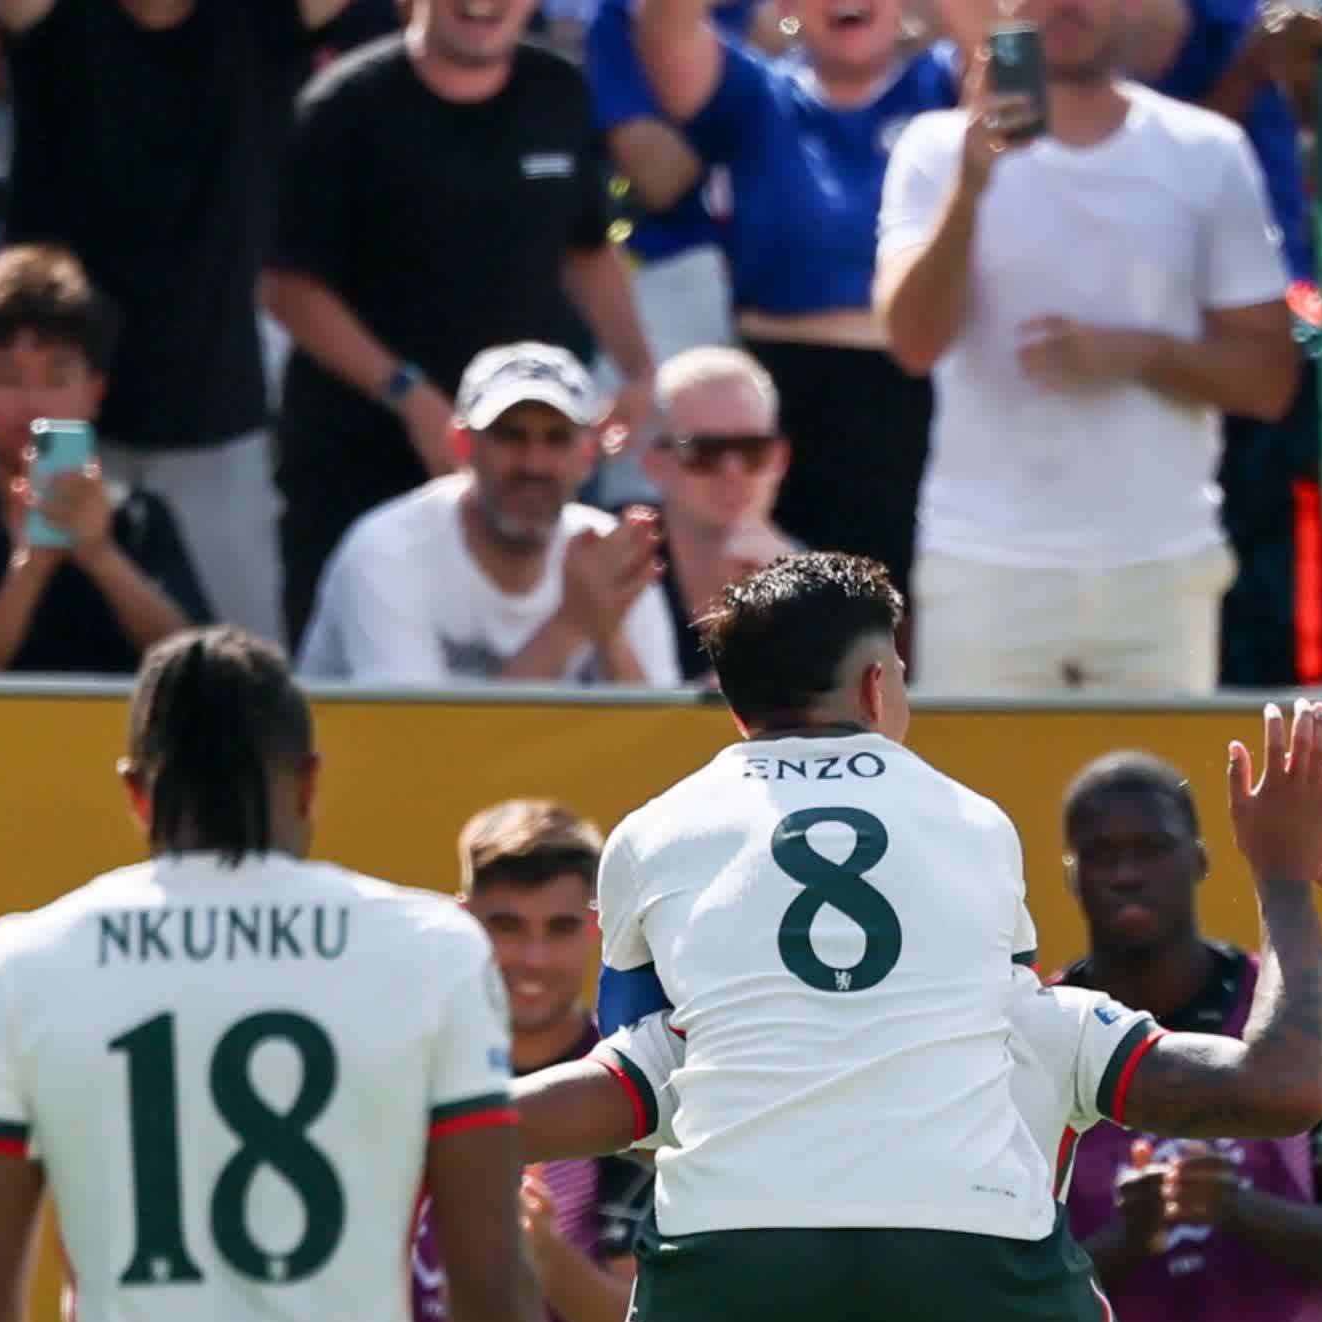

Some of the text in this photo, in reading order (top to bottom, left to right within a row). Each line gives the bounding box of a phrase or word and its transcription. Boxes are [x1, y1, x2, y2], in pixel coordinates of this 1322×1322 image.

[743, 752, 886, 780] ENZO
[98, 905, 349, 966] NKUNKU
[771, 807, 902, 992] 8
[106, 1010, 347, 1287] 18
